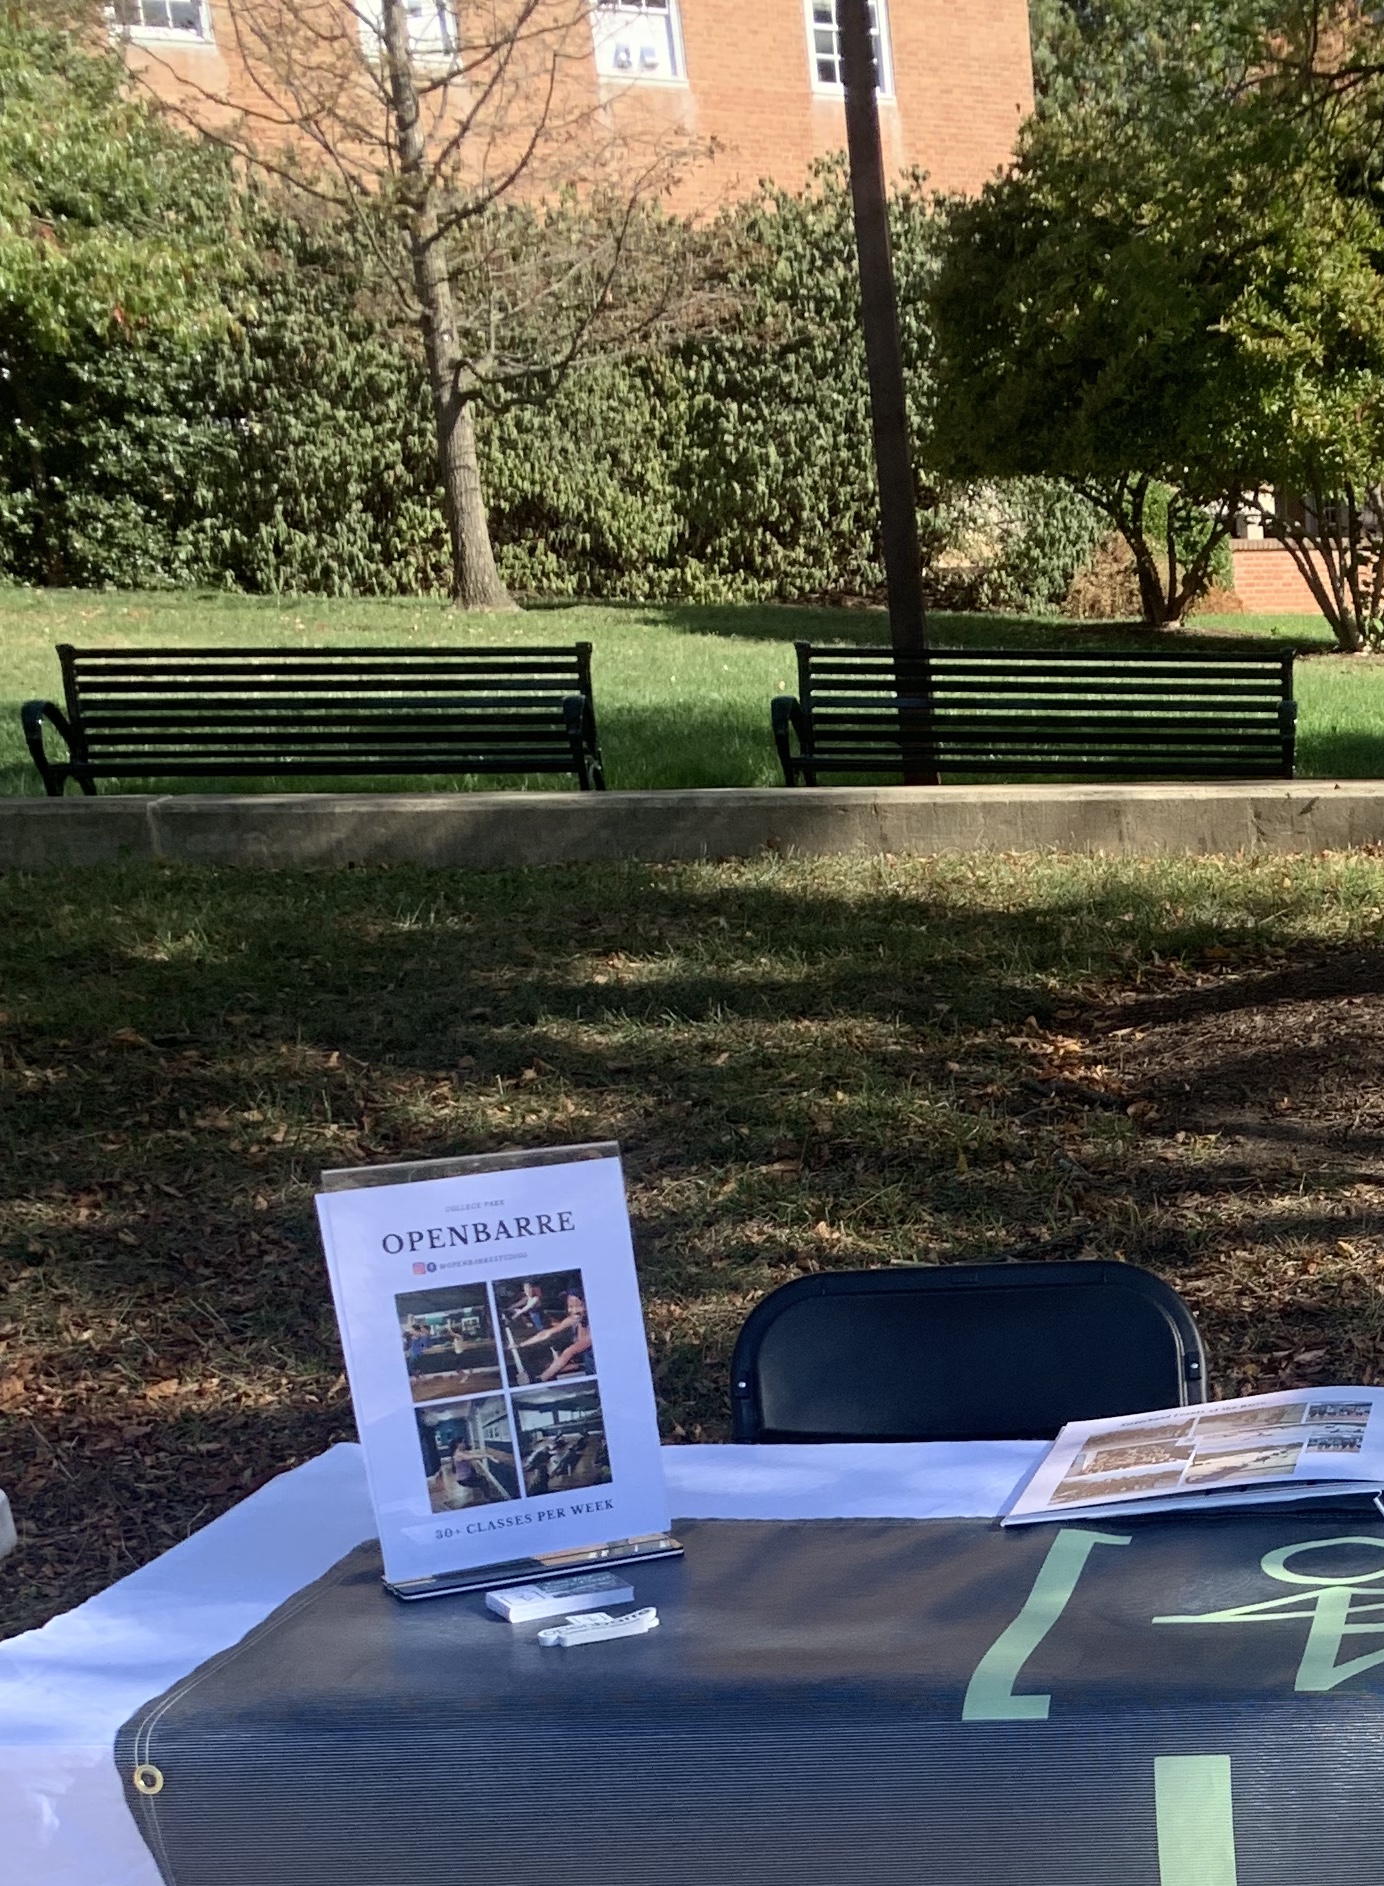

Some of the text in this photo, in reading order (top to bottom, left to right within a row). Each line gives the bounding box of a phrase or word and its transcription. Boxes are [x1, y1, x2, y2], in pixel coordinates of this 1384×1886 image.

[445, 1200, 505, 1213] COLLEGE PARK
[381, 1210, 576, 1255] OPENBARRE
[466, 1513, 533, 1535] CLASSES
[538, 1507, 566, 1522] PER
[571, 1499, 615, 1515] WEEK
